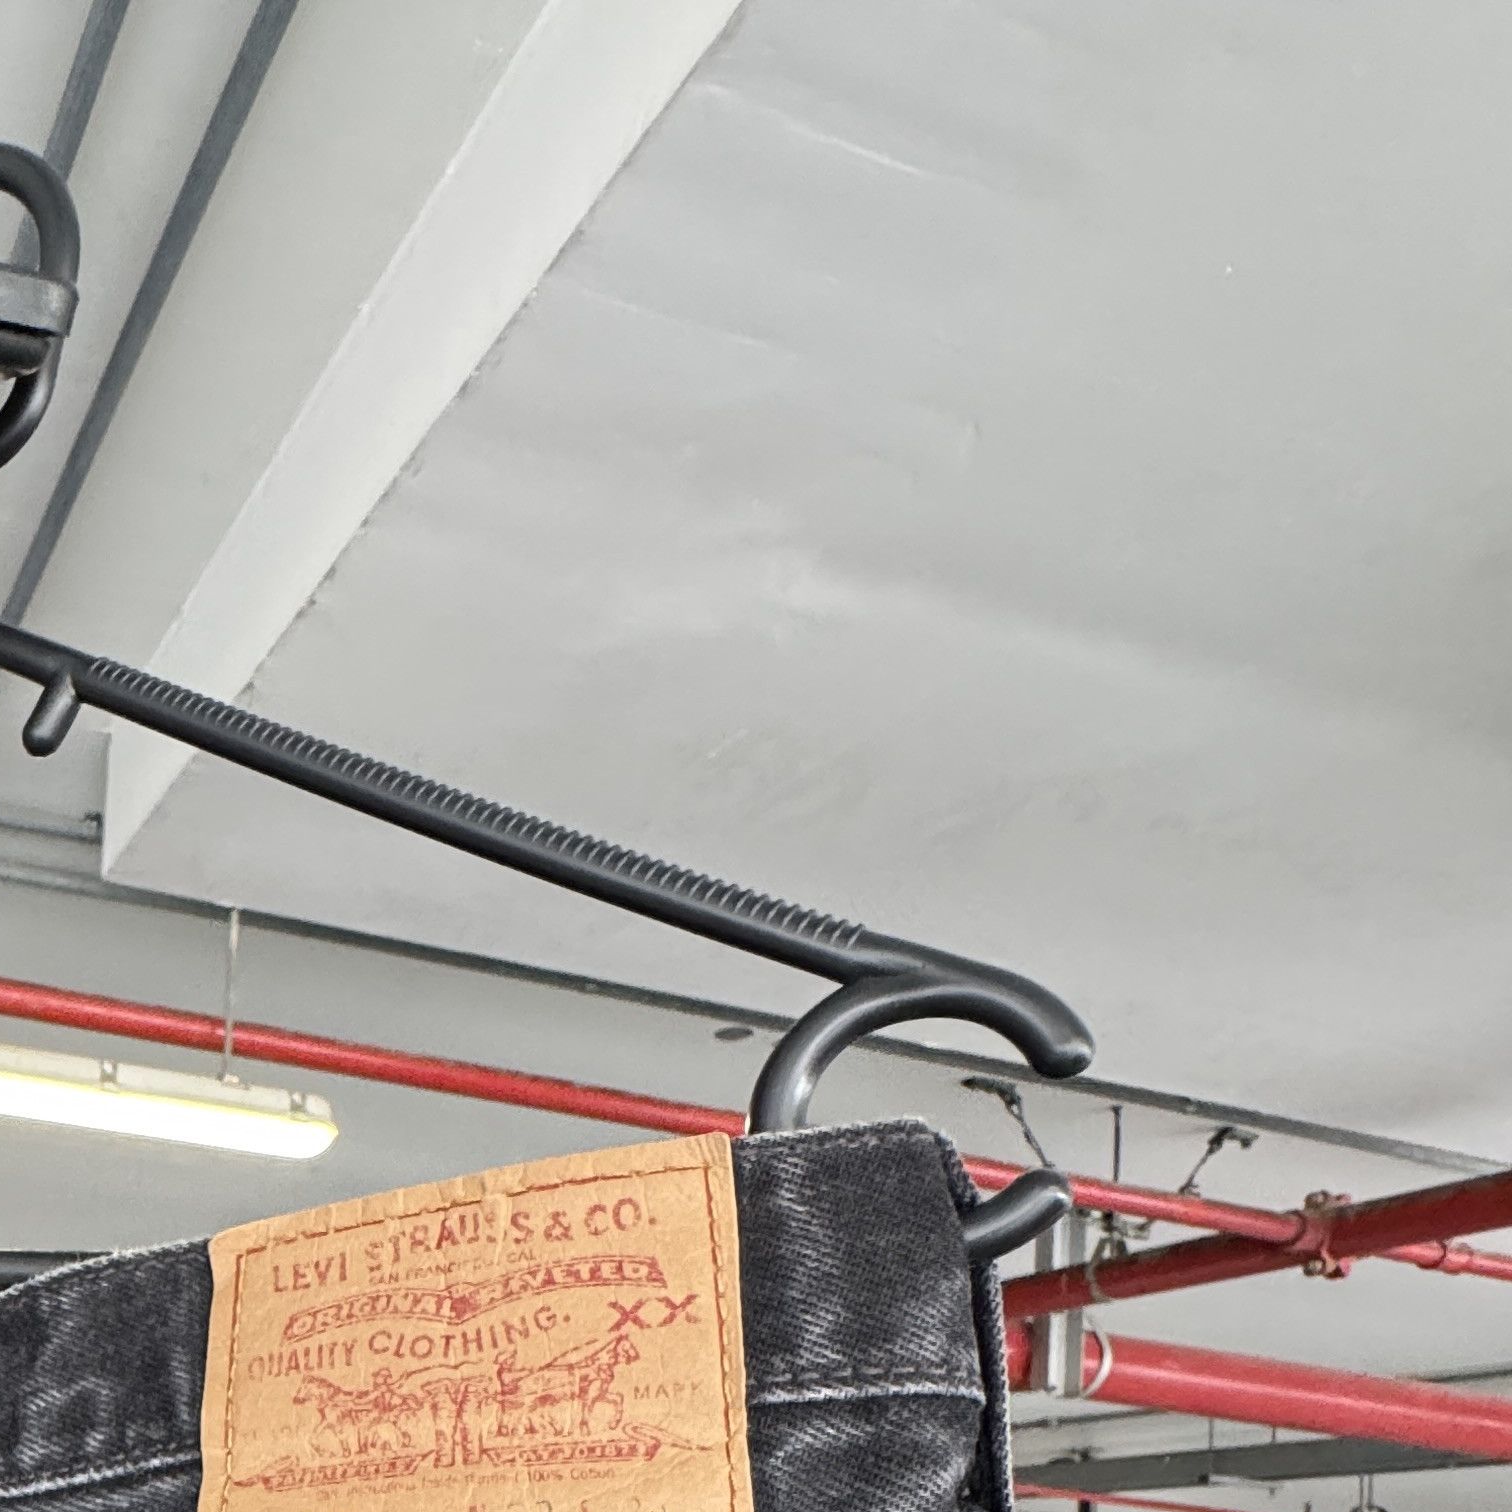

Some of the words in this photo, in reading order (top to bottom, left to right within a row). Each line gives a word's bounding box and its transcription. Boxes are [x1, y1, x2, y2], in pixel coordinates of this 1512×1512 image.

[272, 1252, 348, 1293] LEVI
[543, 1210, 574, 1242] &
[584, 1197, 657, 1236] CO.
[247, 1338, 358, 1382] QUALITY
[368, 1304, 571, 1360] CLOTHING.
[607, 1293, 701, 1334] XX
